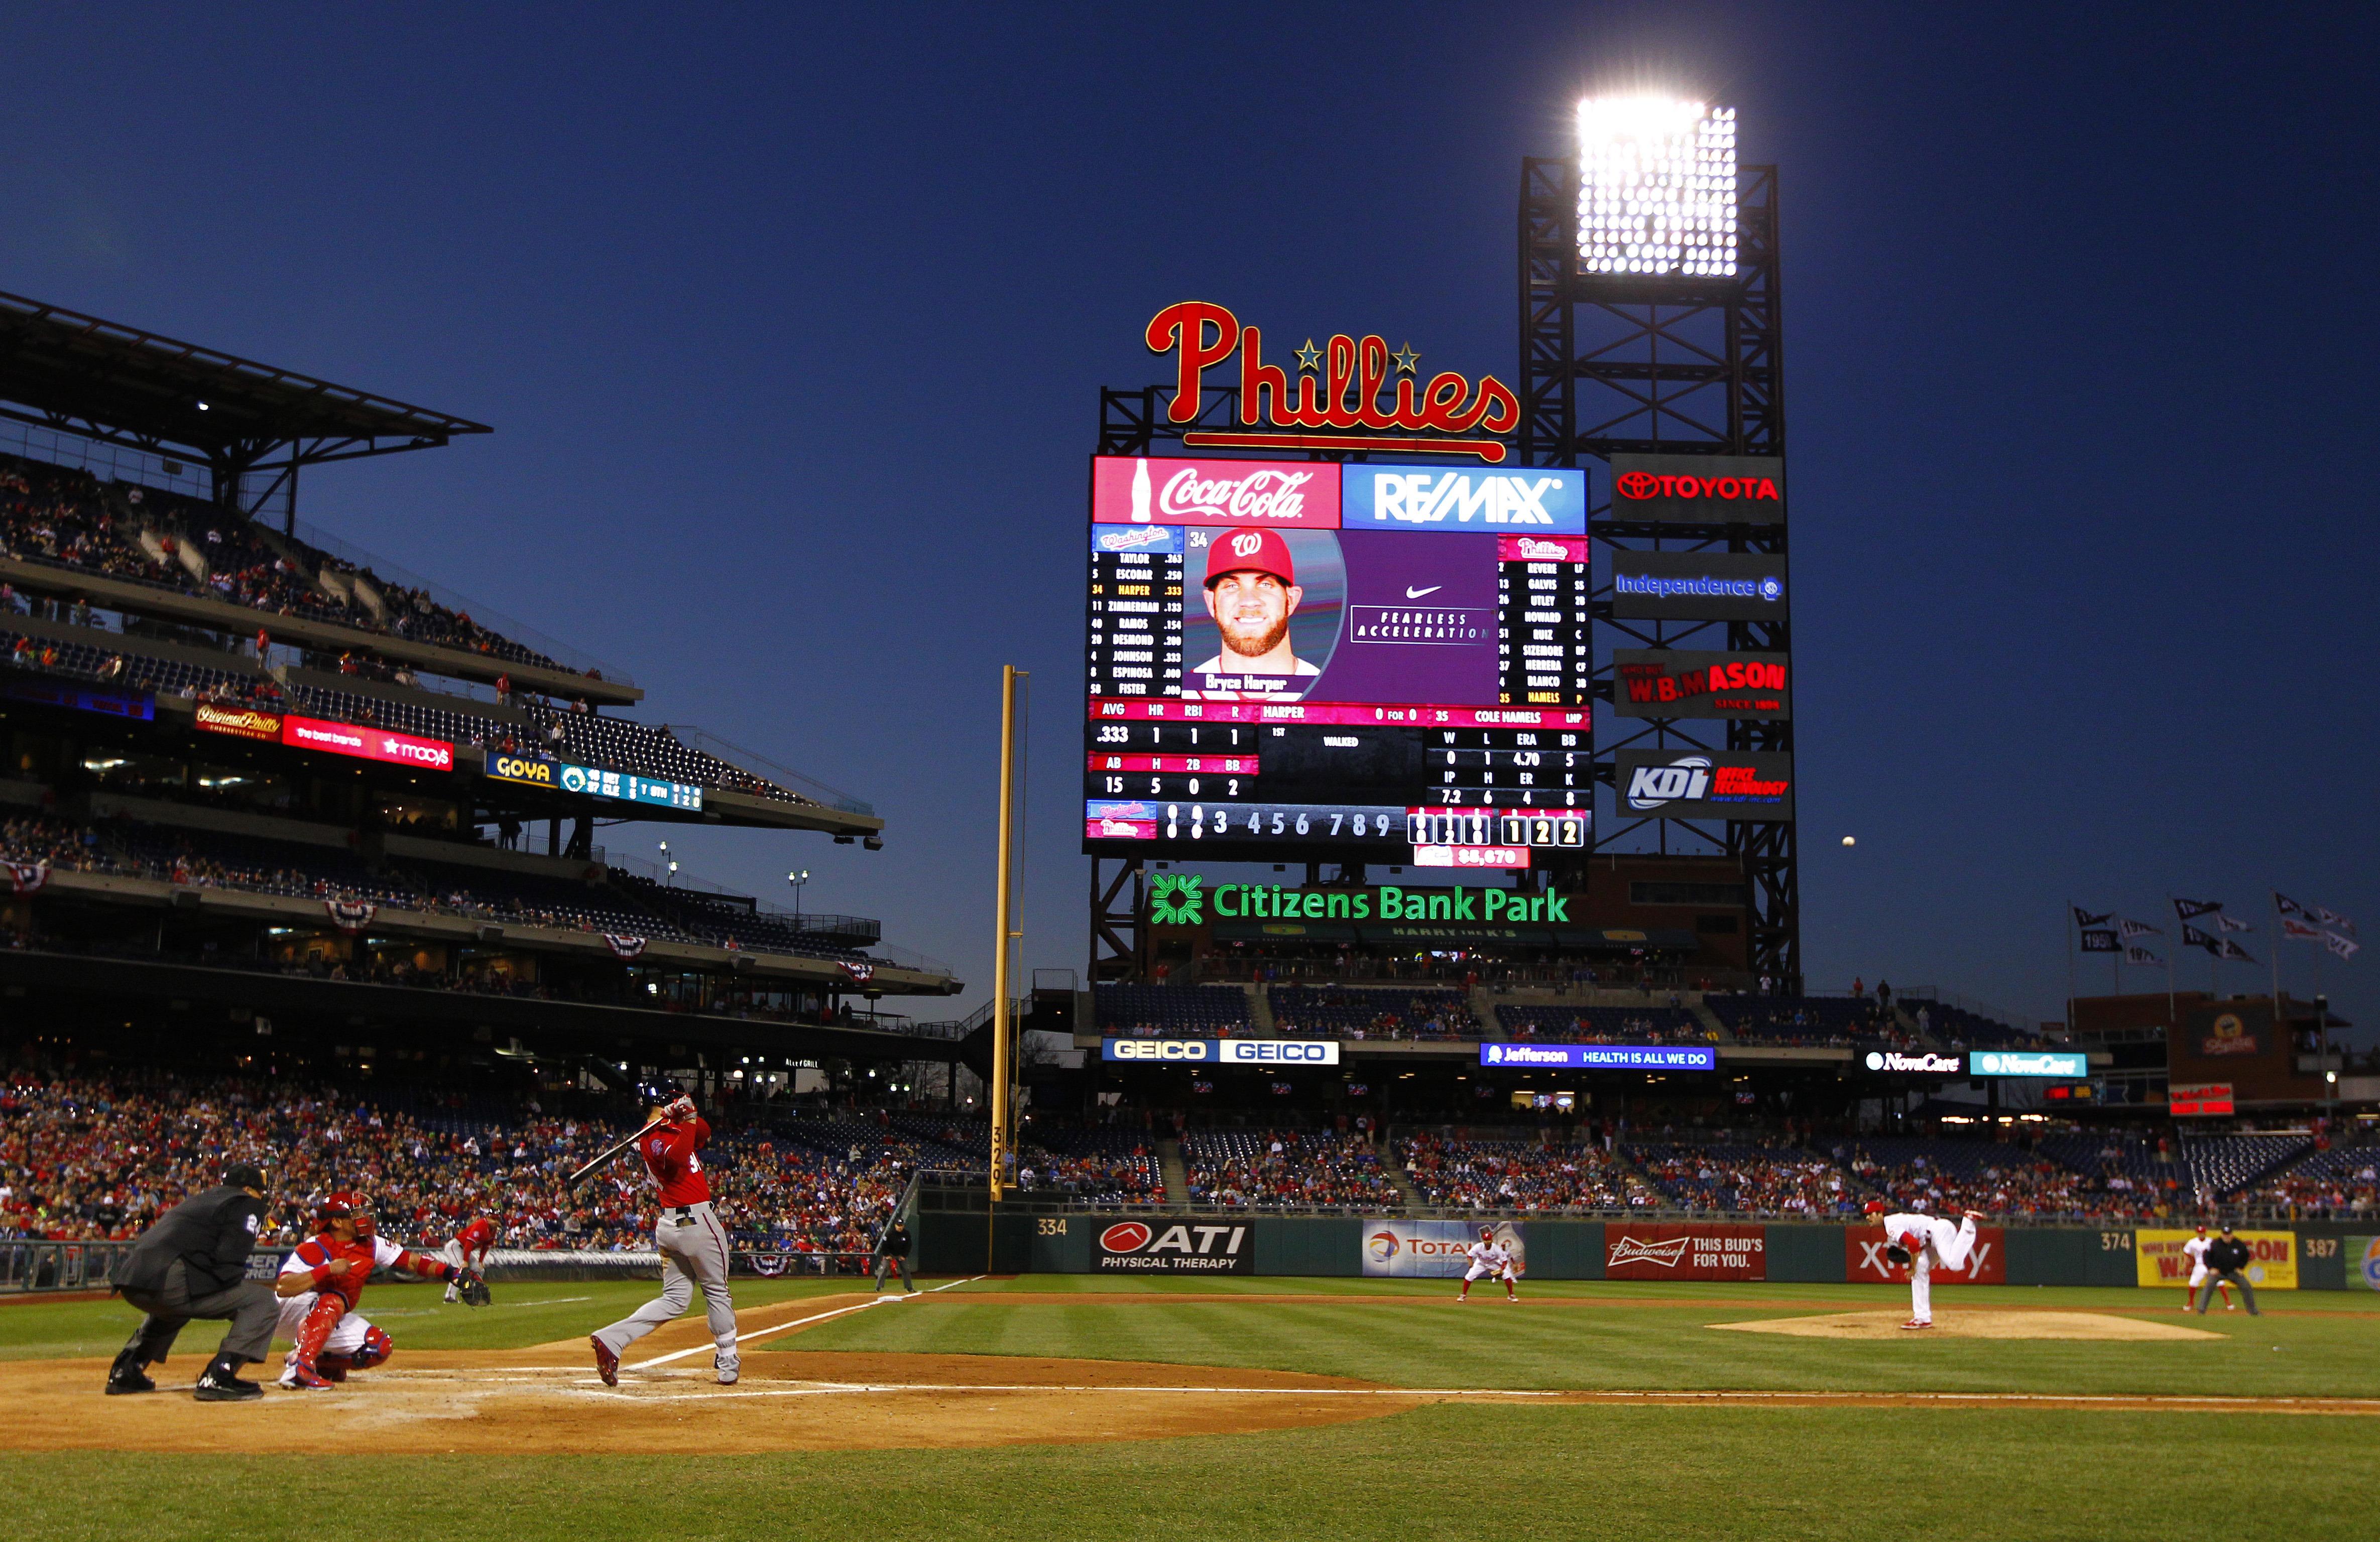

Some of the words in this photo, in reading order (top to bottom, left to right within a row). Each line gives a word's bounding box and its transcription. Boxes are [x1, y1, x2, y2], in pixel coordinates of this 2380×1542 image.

[1145, 301, 1520, 433] Phillies
[1160, 468, 1313, 519] Coca-Cola
[1658, 475, 1779, 500] TOYOTA
[1374, 472, 1554, 524] RE/MAX
[1101, 525, 1168, 549] Washington
[1189, 532, 1208, 548] 34
[1517, 538, 1568, 560] Phillies
[1093, 552, 1099, 562] 3
[1120, 553, 1149, 564] TAYLOR
[1092, 569, 1098, 578] 5
[1116, 569, 1153, 580] ESCOBAR
[1527, 563, 1557, 574] REVERE
[1575, 564, 1584, 573] LF
[1092, 585, 1103, 594] 34
[1118, 585, 1150, 595] HARPER
[1164, 586, 1181, 595] .333
[1499, 579, 1509, 589] 13
[1528, 579, 1557, 590] GALVIS
[1575, 581, 1584, 590] SS
[1617, 574, 1755, 597] Independence
[1093, 601, 1102, 610] 11
[1108, 601, 1159, 612] ZIMMERMAN
[1164, 603, 1182, 612] .133
[1498, 594, 1509, 604] 26
[1530, 595, 1555, 606] UTLEY
[1092, 618, 1103, 628] 40
[1119, 618, 1148, 629] RAMOS
[1381, 613, 1466, 624] FEARLESS
[1524, 612, 1561, 623] HOWARD
[1357, 626, 1489, 638] ACCELERATION
[1499, 628, 1508, 638] 51
[1533, 629, 1553, 640] RUIZ
[1575, 630, 1581, 639] C
[1091, 634, 1102, 645] 20
[1113, 634, 1153, 645] DESMOND
[1091, 651, 1097, 661] 4
[1113, 651, 1153, 662] JOHNSON
[1163, 653, 1181, 662] .333
[1499, 645, 1509, 654] 24
[1523, 645, 1564, 656] SIZEMORE
[1113, 667, 1153, 678] ESPINOSA
[1499, 661, 1510, 671] 37
[1525, 660, 1562, 671] HERRERA
[1576, 662, 1586, 672] CF
[1119, 683, 1146, 694] FISTER
[1206, 676, 1242, 689] Bryce
[1244, 676, 1287, 693] Harper
[1499, 677, 1505, 687] 4
[1527, 676, 1560, 687] BLANCO
[1500, 693, 1510, 703] 35
[1528, 692, 1560, 703] HAMELS
[1577, 695, 1582, 704] P
[1714, 699, 1752, 709] SINCE
[1103, 704, 1125, 715] AVG
[1148, 705, 1164, 716] HR
[1184, 705, 1202, 717] RBI
[1232, 707, 1239, 717] R
[1263, 706, 1304, 718] HARPER
[1375, 708, 1383, 720] 0
[1388, 711, 1403, 720] FOR
[1409, 708, 1417, 721] 0
[1436, 711, 1448, 722] 35
[1475, 711, 1500, 722] COLE
[1502, 711, 1541, 723] HAMELS
[1566, 713, 1583, 724] LHP
[244, 712, 281, 733] Philly
[298, 727, 311, 739] the
[313, 730, 331, 742] best
[333, 733, 362, 747] brands
[1097, 726, 1129, 743] .333
[1153, 727, 1160, 743] 1
[1191, 728, 1198, 744] 1
[1231, 729, 1238, 745] 1
[1272, 728, 1285, 737] 1ST
[1444, 732, 1456, 744] W
[1484, 733, 1490, 744] L
[1517, 733, 1536, 745] ERA
[1562, 734, 1576, 746] BB
[1324, 736, 1359, 747] WALKED
[403, 743, 448, 766] macy's
[1447, 751, 1456, 764] 0
[1485, 752, 1491, 765] 1
[1513, 752, 1540, 766] 4.70
[1565, 753, 1574, 766] 5
[497, 757, 550, 782] GOYA
[1106, 757, 1121, 768] AB
[1152, 758, 1160, 769] H
[1186, 759, 1201, 770] 2B
[1225, 759, 1240, 772] BB
[1444, 771, 1455, 783] IP
[1484, 772, 1493, 784] H
[1520, 773, 1533, 785] ER
[1566, 774, 1573, 786] K
[1715, 766, 1756, 781] OFFICE
[1106, 777, 1123, 793] 15
[1151, 778, 1161, 794] 5
[1189, 779, 1199, 795] 0
[1228, 780, 1238, 796] 2
[1442, 789, 1461, 804] 7.2
[1484, 790, 1493, 804] 6
[1523, 791, 1531, 805] 4
[1566, 792, 1575, 805] 8
[1214, 811, 1227, 834] 3
[1248, 813, 1260, 834] 4
[1271, 813, 1284, 835] 5
[1295, 814, 1309, 835] 6
[1330, 814, 1344, 836] 7
[1353, 815, 1366, 836] 8
[1376, 815, 1389, 836] 9
[1510, 821, 1519, 842] 1
[1536, 821, 1549, 842] 2
[1564, 821, 1576, 843] 2
[1213, 883, 1370, 919] Citizens
[1380, 885, 1476, 921] Bank
[1484, 887, 1570, 923] Park
[1393, 927, 1456, 937] HARRY
[1487, 929, 1516, 938] K'S
[1114, 1040, 1207, 1060] GEICO
[1235, 1044, 1325, 1061] GEICO
[1504, 1047, 1568, 1063] Jefferson
[1583, 1052, 1628, 1063] HEALTH
[1631, 1053, 1641, 1063] IS
[1643, 1053, 1664, 1064] ALL
[1667, 1054, 1685, 1064] WE
[1688, 1054, 1707, 1065] DO
[1883, 1053, 1959, 1072] NovaCare
[1999, 1055, 2075, 1074] NovaCare
[994, 1127, 1002, 1185] 329
[1038, 1218, 1067, 1235] 334
[1147, 1226, 1245, 1254] ATI
[1693, 1238, 1721, 1251] THIS
[1725, 1238, 1762, 1252] BUD'S
[2101, 1232, 2130, 1251] 374
[1610, 1243, 1685, 1257] Budweiser
[2306, 1239, 2337, 1258] 387
[1102, 1257, 1168, 1268] PHYSICAL
[1173, 1258, 1237, 1269] THERAPY
[1694, 1254, 1718, 1267] FOR
[1721, 1254, 1750, 1267] YOU.
